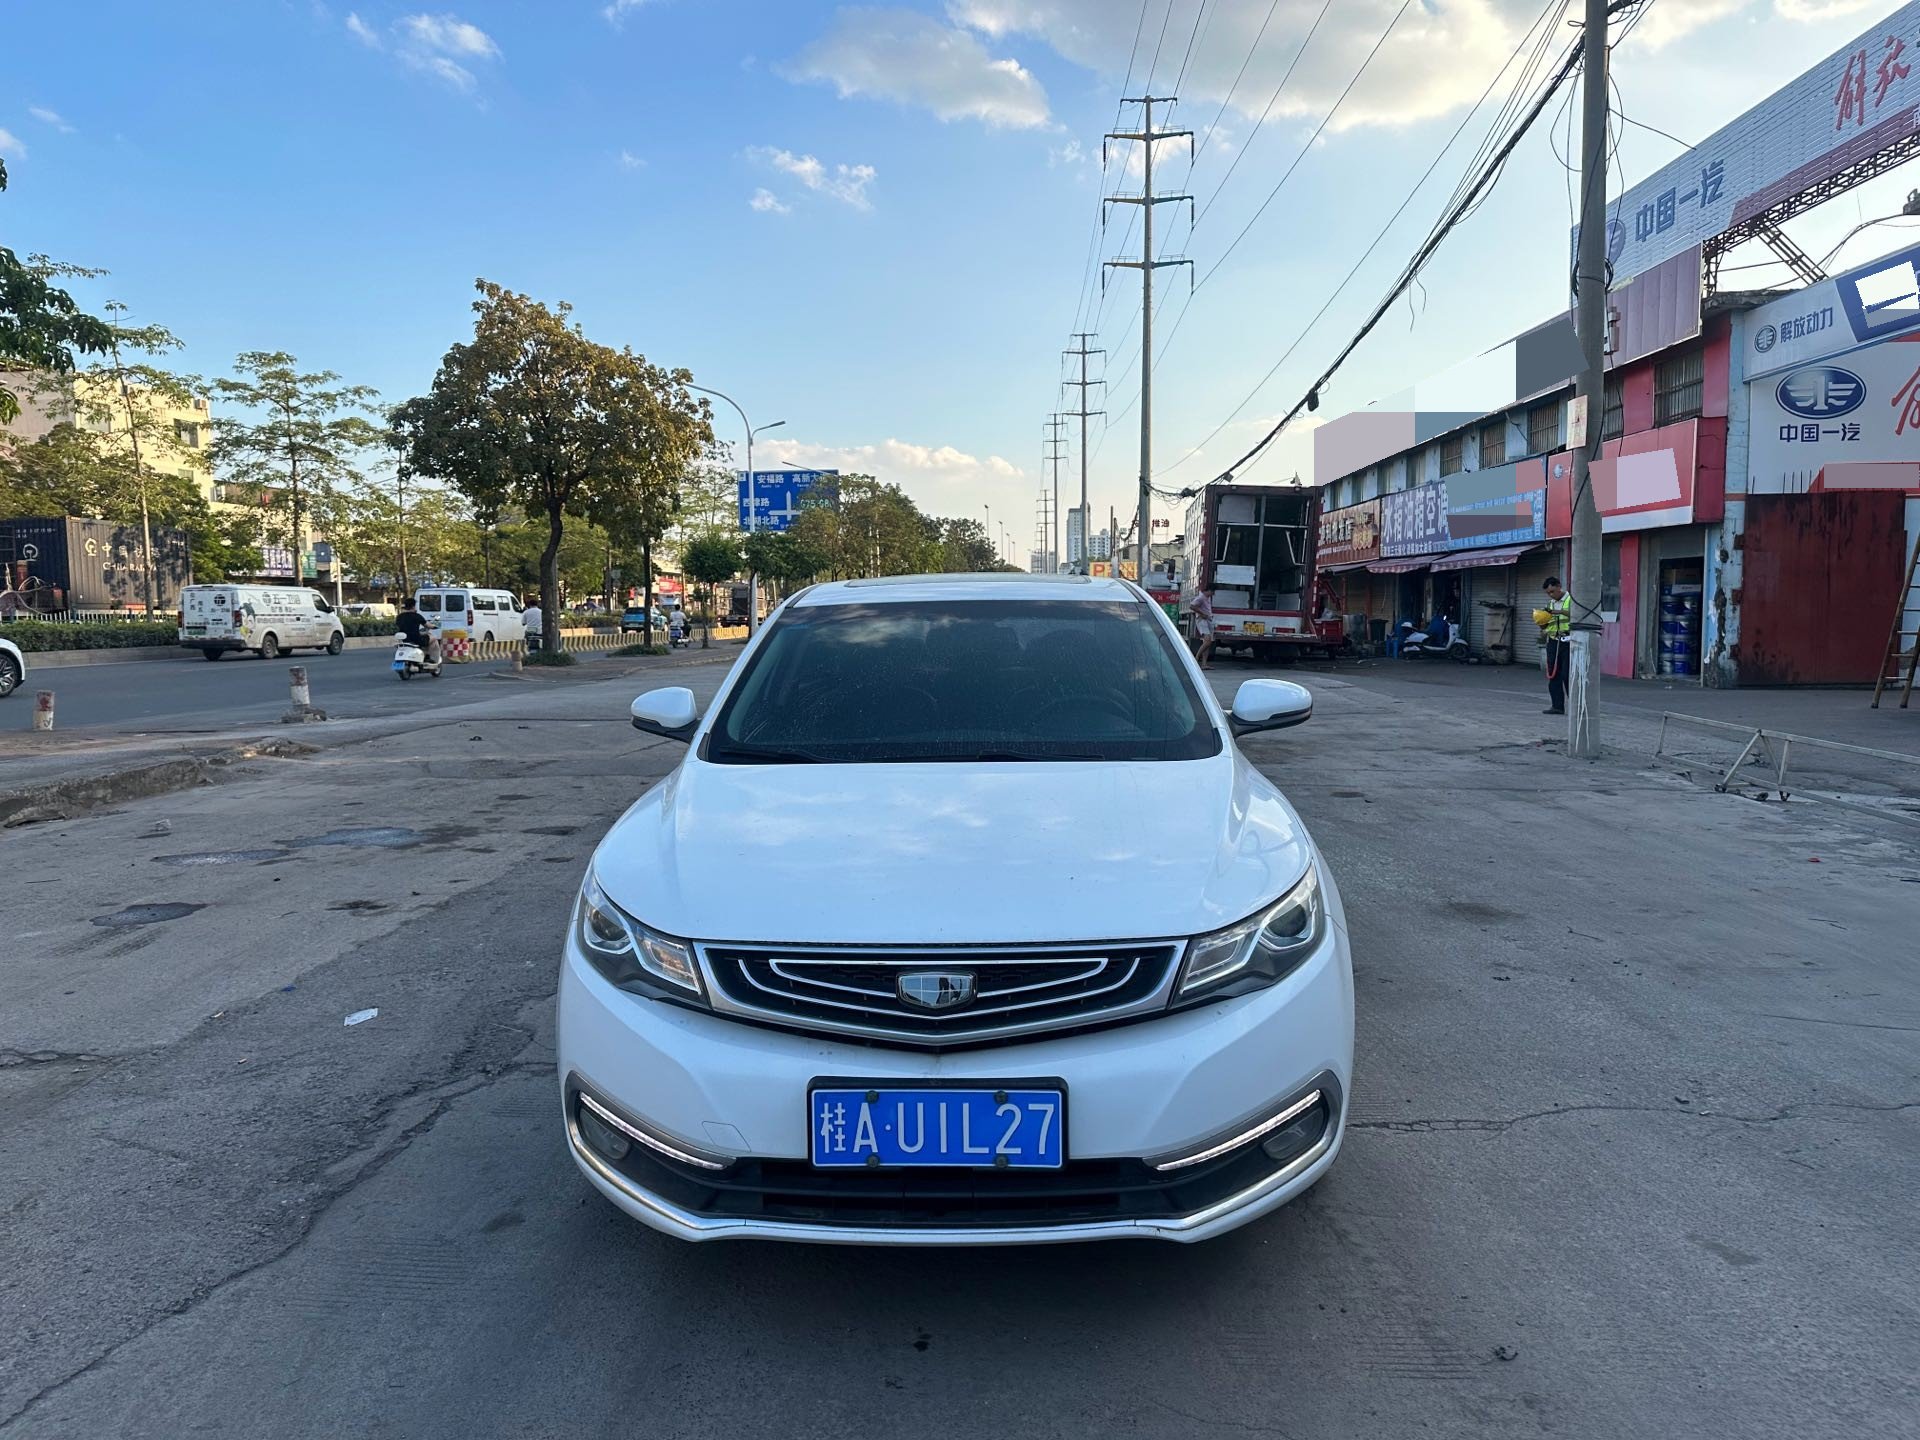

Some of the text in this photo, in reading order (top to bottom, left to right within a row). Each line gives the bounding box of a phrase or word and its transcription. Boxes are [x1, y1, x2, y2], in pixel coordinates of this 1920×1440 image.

[1635, 160, 1725, 243] 中国一汽
[1780, 306, 1833, 344] 解放动力
[1779, 423, 1861, 443] 中国一汽
[1384, 483, 1449, 543] 水箱油箱空调
